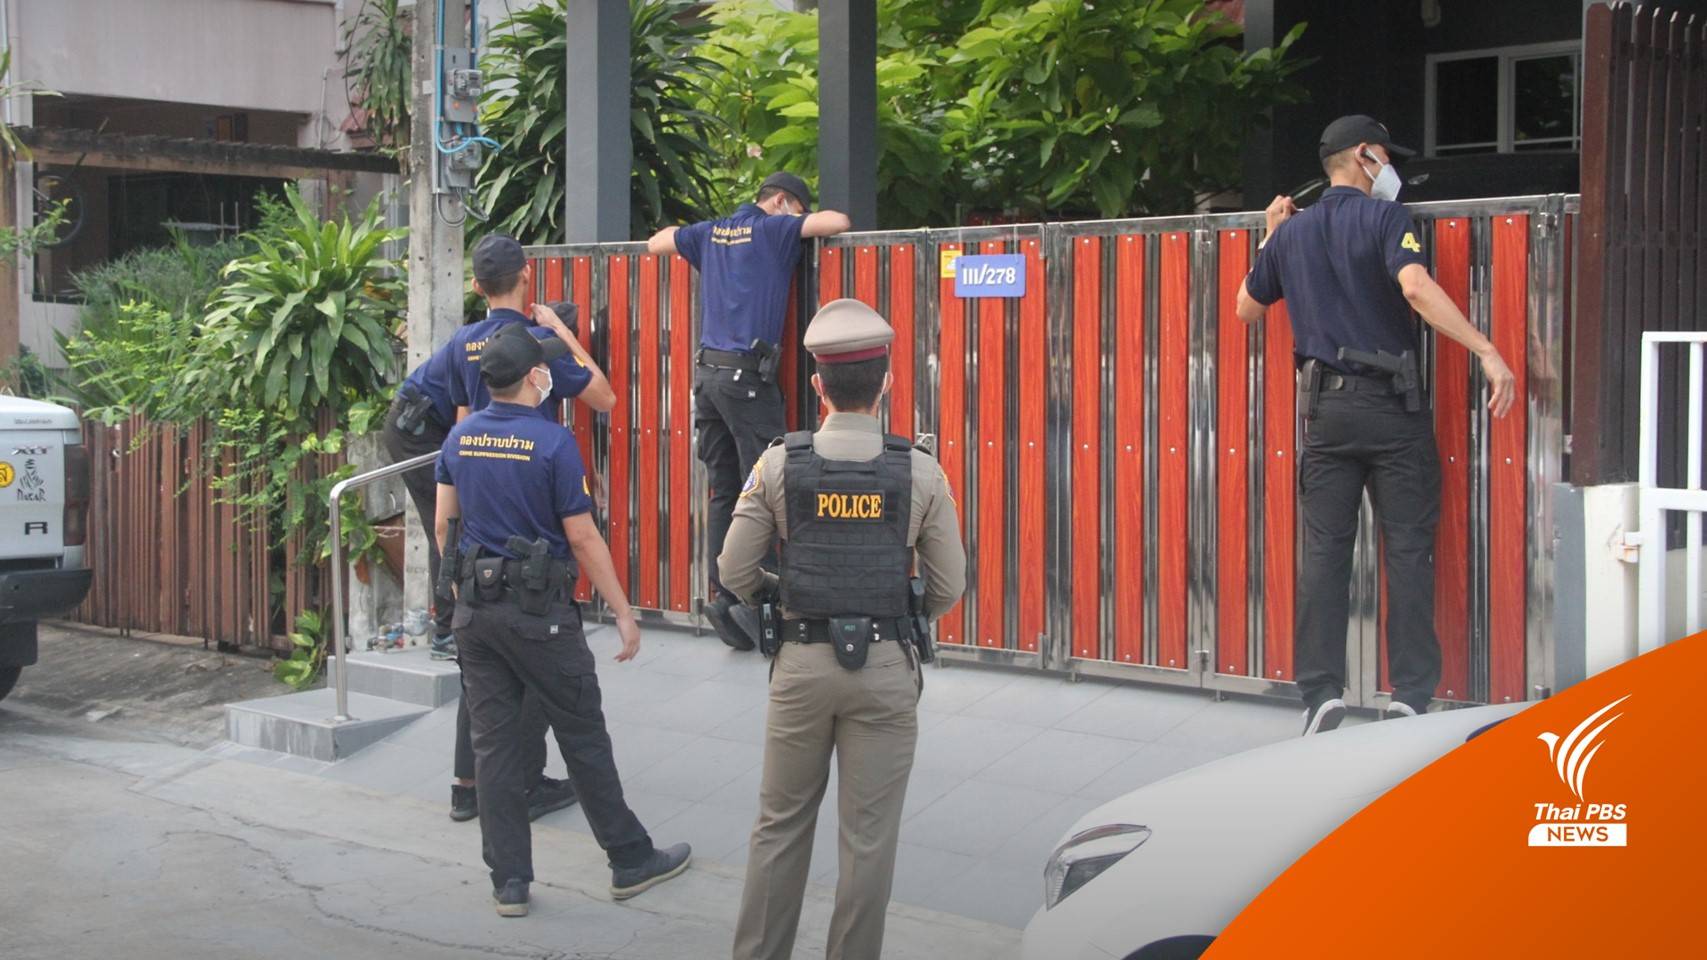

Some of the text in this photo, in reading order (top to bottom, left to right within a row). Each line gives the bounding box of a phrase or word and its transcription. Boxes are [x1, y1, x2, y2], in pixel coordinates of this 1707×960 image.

[1401, 232, 1420, 253] 4
[817, 493, 881, 518] POLICE
[25, 521, 48, 535] R
